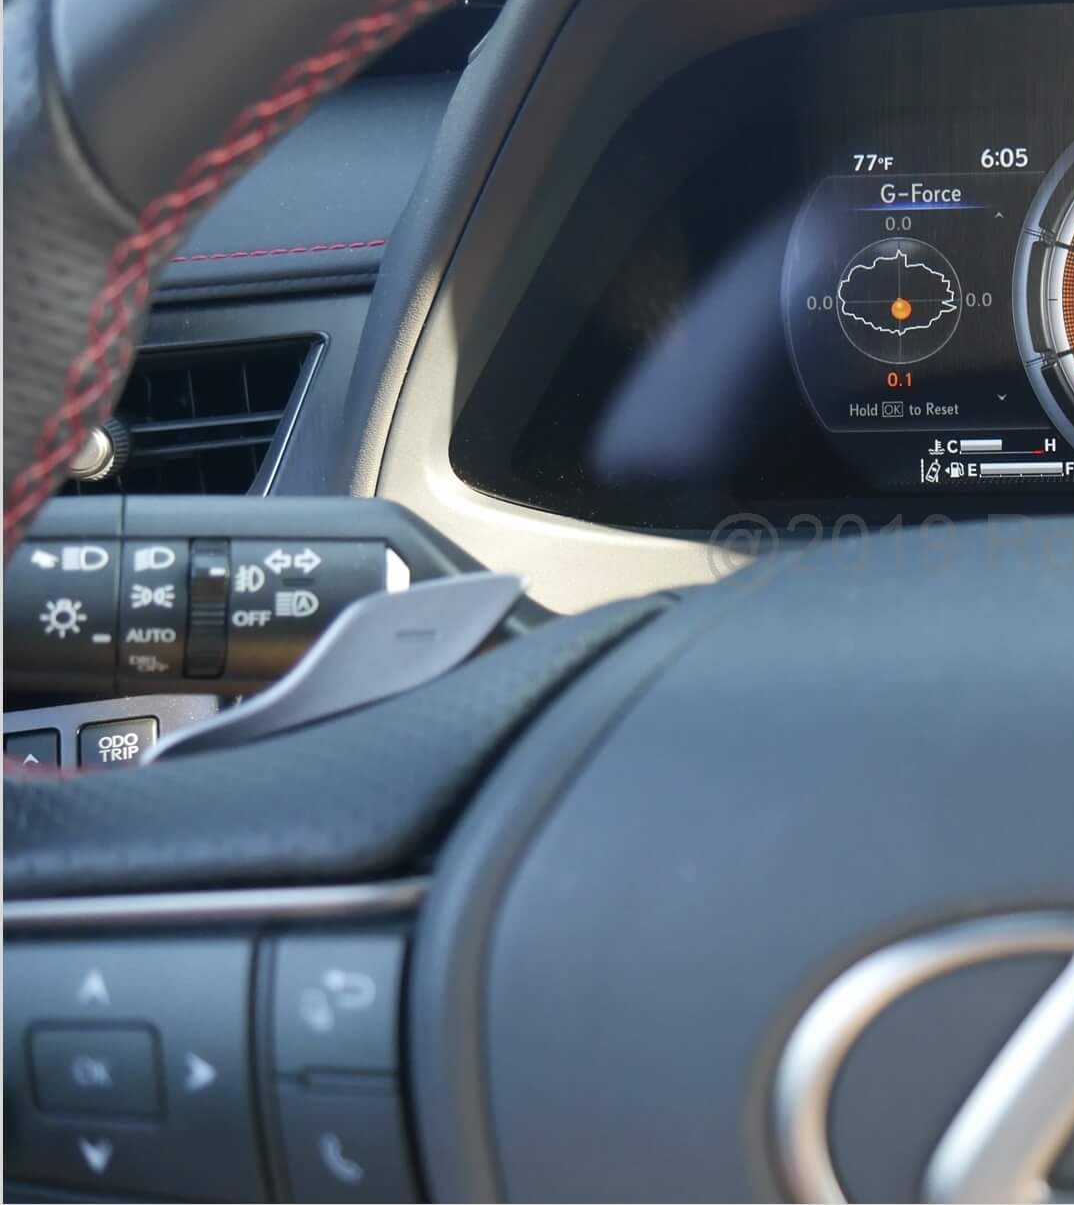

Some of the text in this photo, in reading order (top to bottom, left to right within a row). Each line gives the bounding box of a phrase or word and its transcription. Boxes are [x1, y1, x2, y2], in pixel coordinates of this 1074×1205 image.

[980, 148, 1029, 169] 6:05
[880, 183, 962, 204] G-Force
[885, 216, 912, 232] 0.0
[806, 296, 833, 311] 0.0
[965, 293, 993, 308] 0.0
[887, 372, 912, 388] 0.1
[849, 401, 960, 417] Hold OK to Reset
[946, 440, 958, 454] C
[1044, 438, 1056, 452] H
[967, 463, 977, 477] E
[1065, 461, 1074, 475] F
[232, 609, 272, 627] OFF
[126, 628, 176, 643] AUTO
[98, 732, 138, 749] ODO
[98, 745, 139, 763] TRIP
